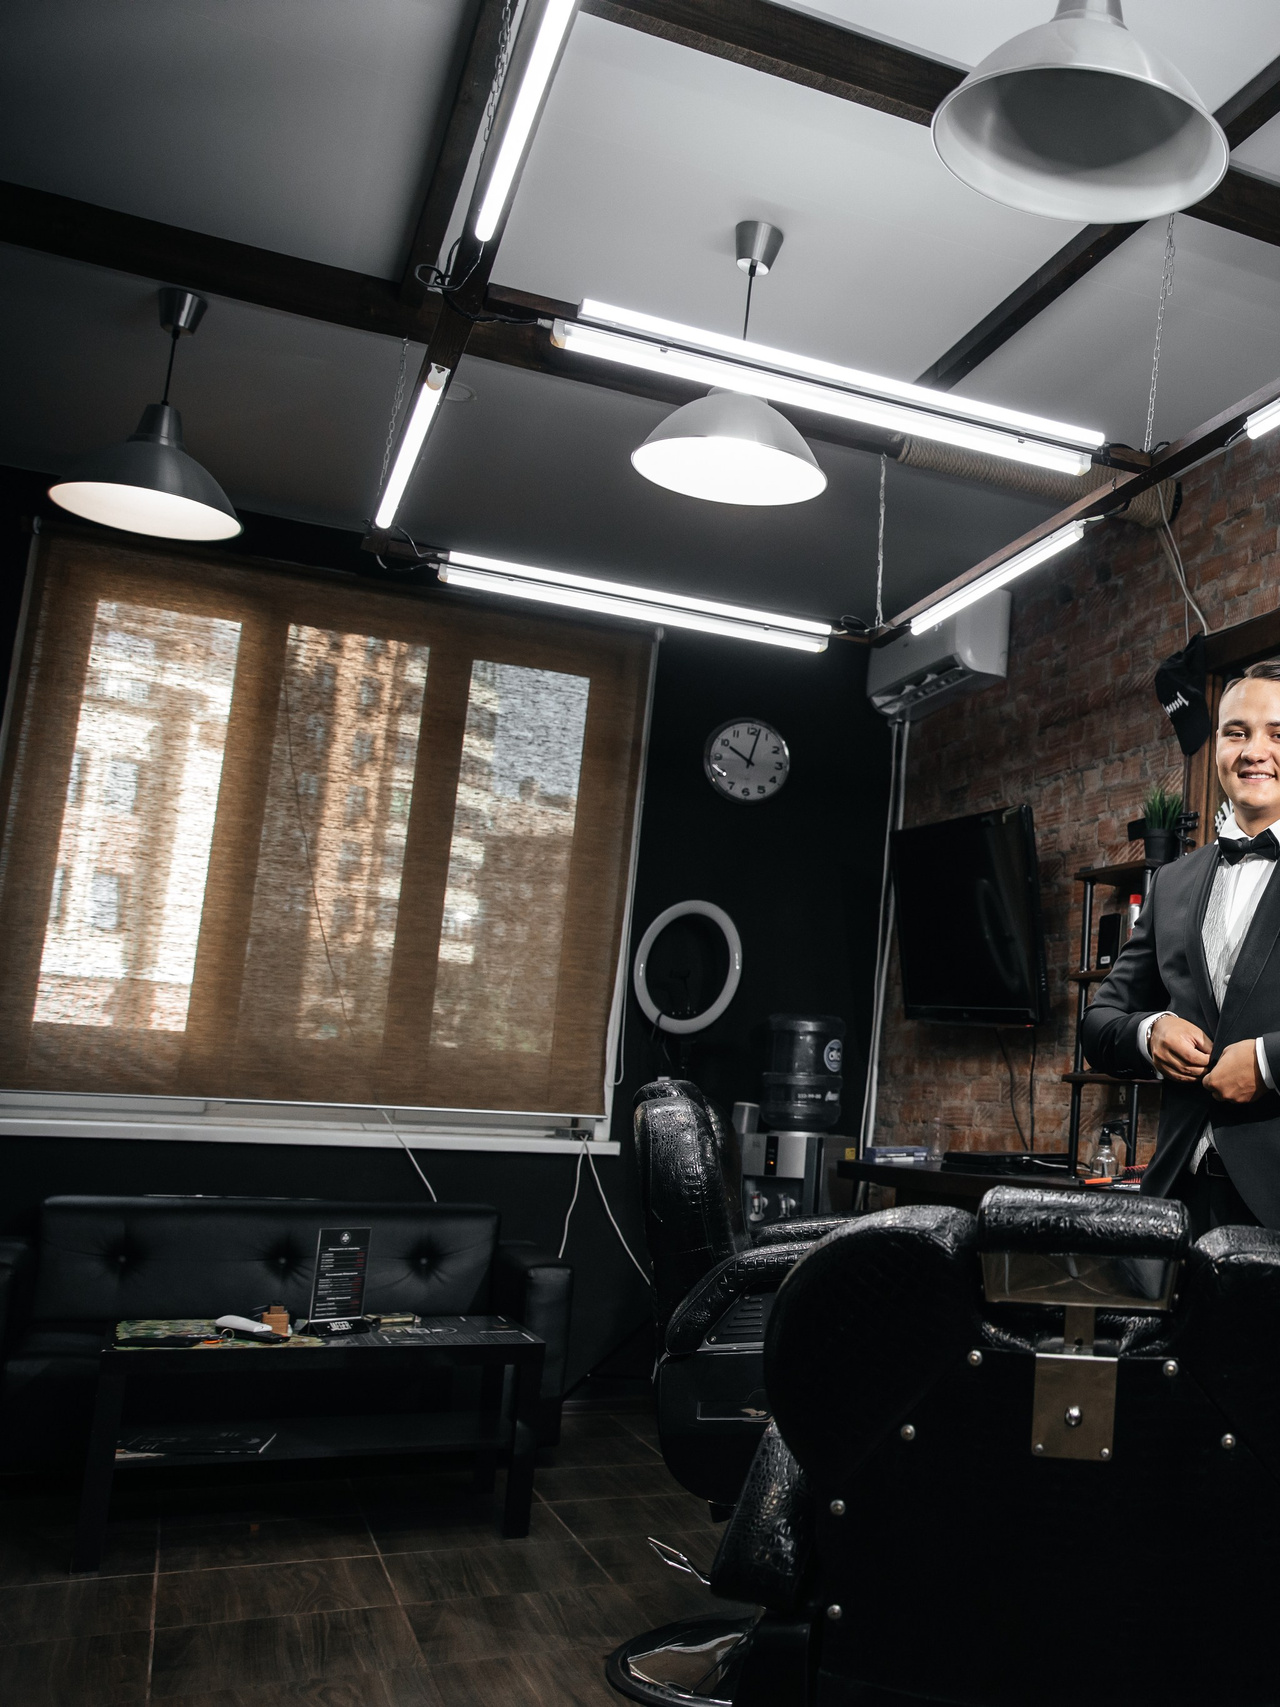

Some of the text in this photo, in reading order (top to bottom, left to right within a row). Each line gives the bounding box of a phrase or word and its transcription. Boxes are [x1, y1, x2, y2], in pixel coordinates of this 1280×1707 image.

[747, 727, 758, 736] 12
[721, 739, 730, 747] 10
[771, 746, 780, 755] 2
[774, 762, 783, 770] 3
[769, 776, 777, 784] 4
[727, 781, 735, 790] 7
[757, 785, 766, 794] 5
[741, 787, 750, 796] 6
